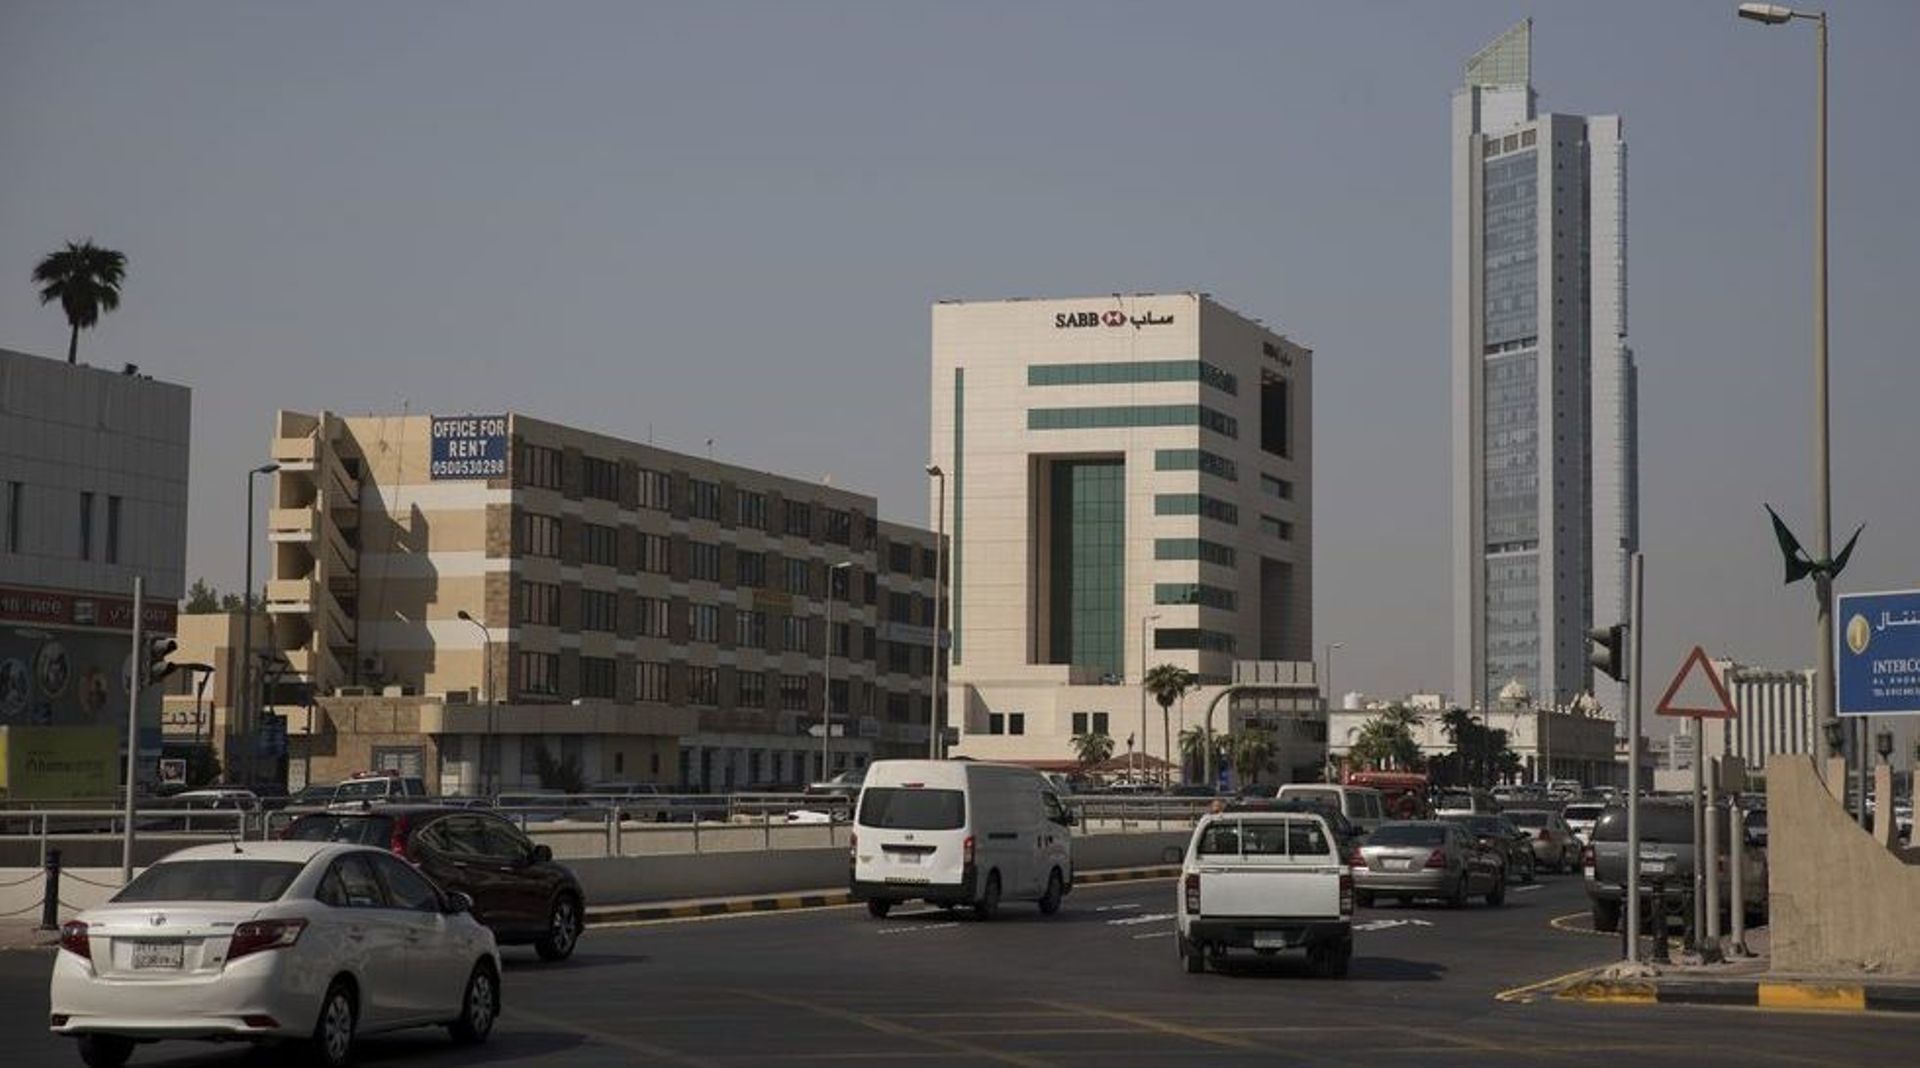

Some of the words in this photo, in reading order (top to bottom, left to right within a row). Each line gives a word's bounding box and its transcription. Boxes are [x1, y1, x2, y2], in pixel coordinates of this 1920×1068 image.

[1055, 312, 1099, 328] SABB
[1130, 310, 1174, 330] ساب
[433, 420, 477, 438] OFFICE
[480, 419, 505, 437] FOR
[449, 440, 487, 457] RENT
